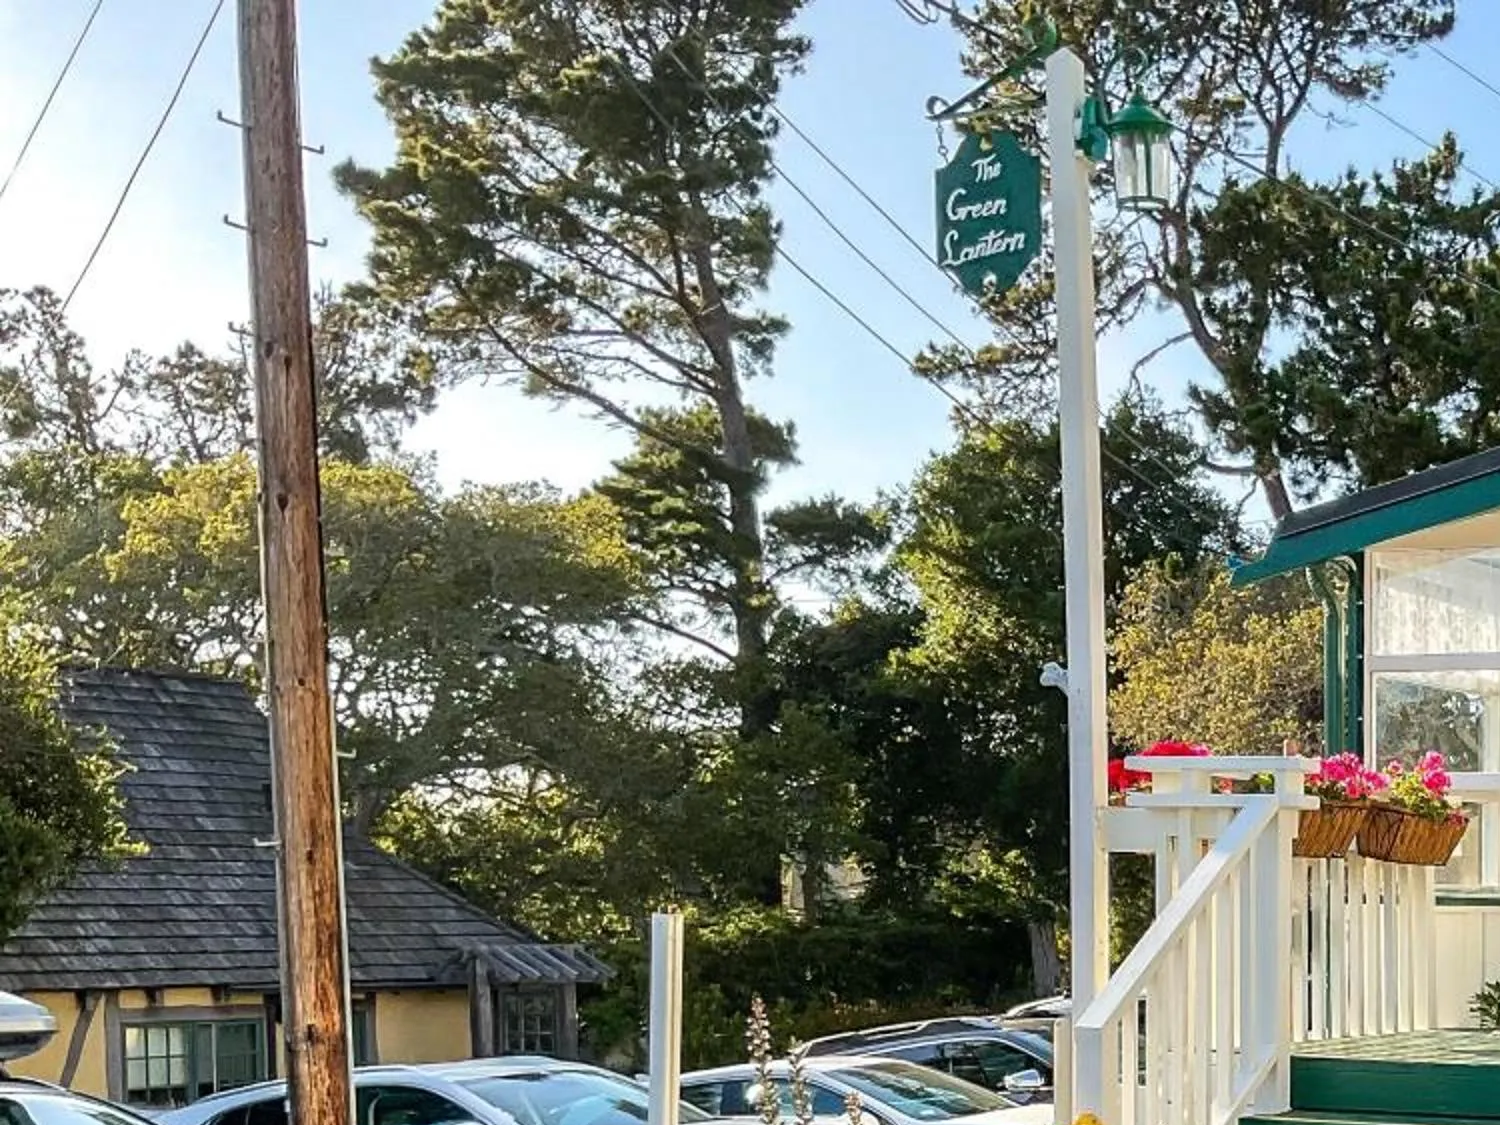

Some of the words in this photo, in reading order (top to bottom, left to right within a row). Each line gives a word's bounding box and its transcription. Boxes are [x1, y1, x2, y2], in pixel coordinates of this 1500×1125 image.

[971, 154, 1001, 183] The
[946, 188, 1007, 221] Green
[941, 229, 1026, 266] Lantern
